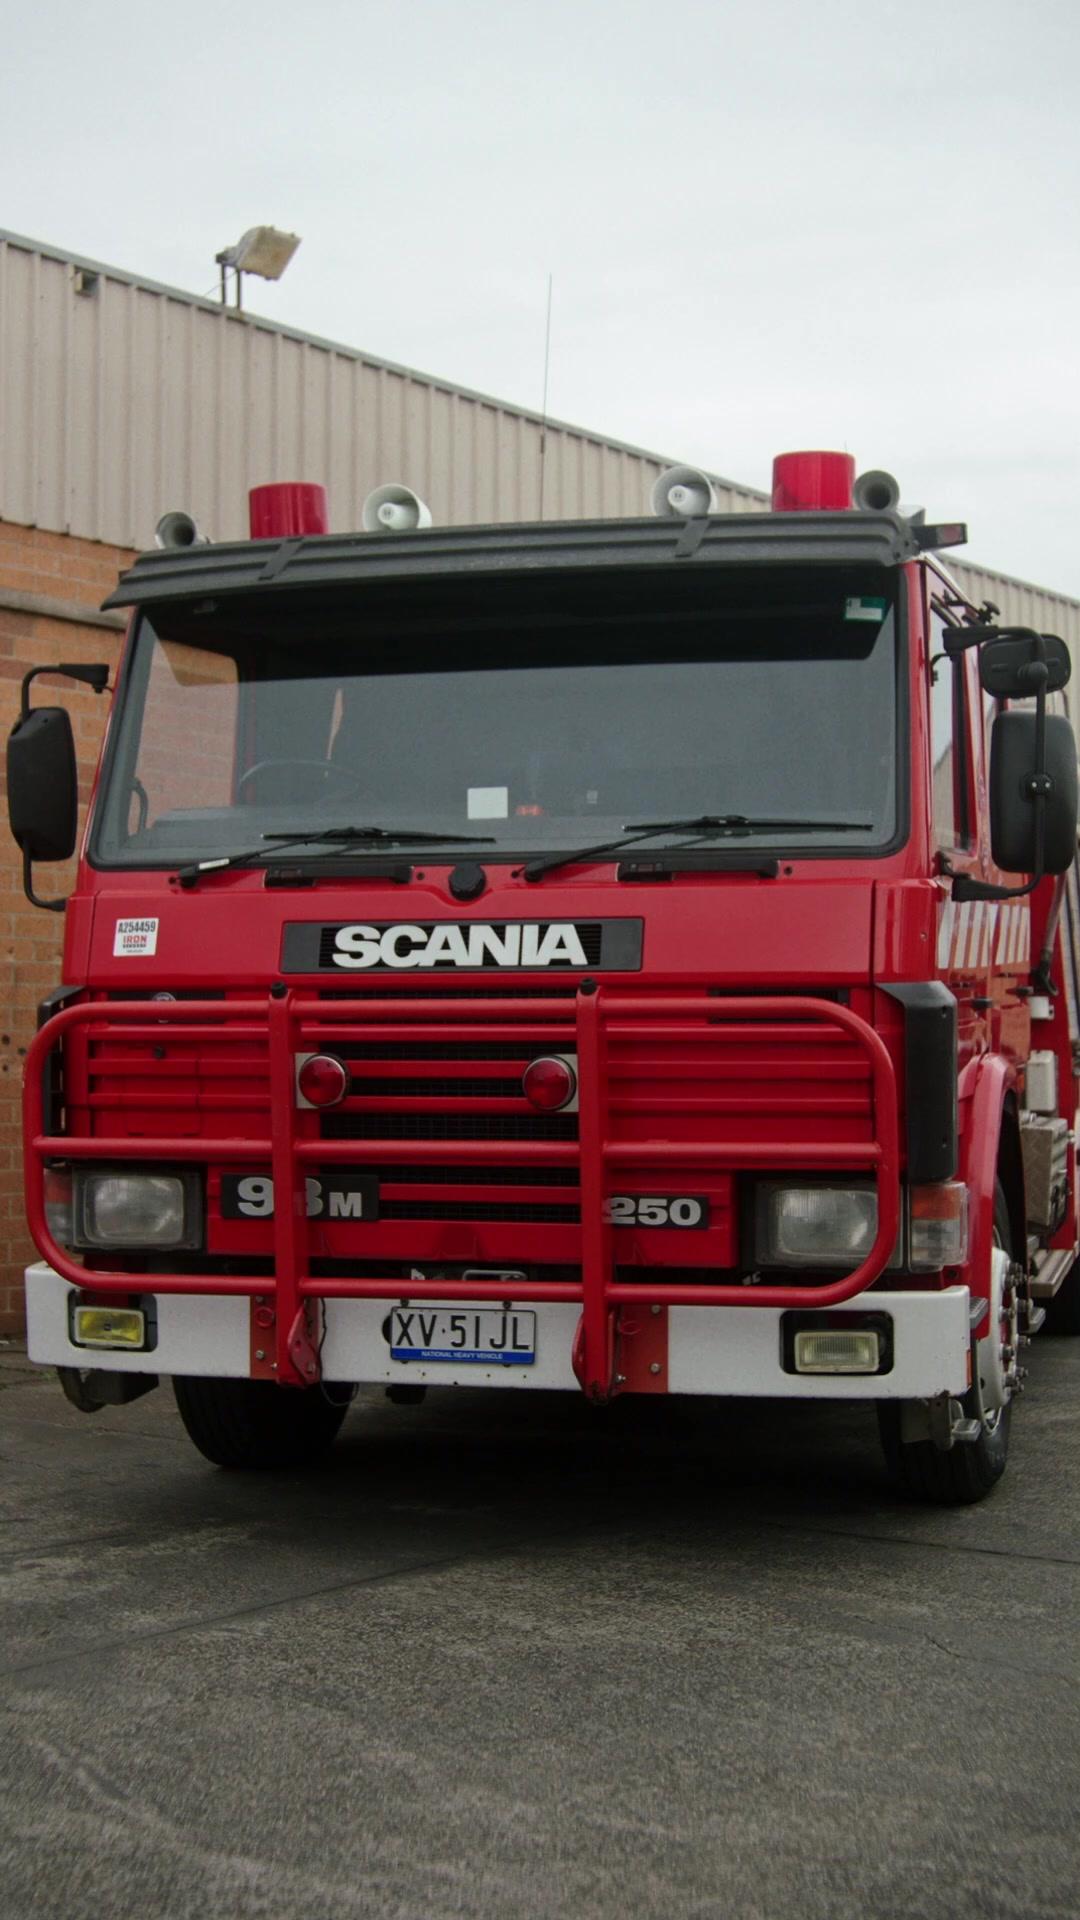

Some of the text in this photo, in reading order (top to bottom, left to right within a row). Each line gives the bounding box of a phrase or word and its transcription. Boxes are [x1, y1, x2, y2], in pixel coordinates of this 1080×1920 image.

[123, 934, 147, 944] IRON
[332, 924, 588, 968] SCANIA
[606, 1197, 702, 1226] 250
